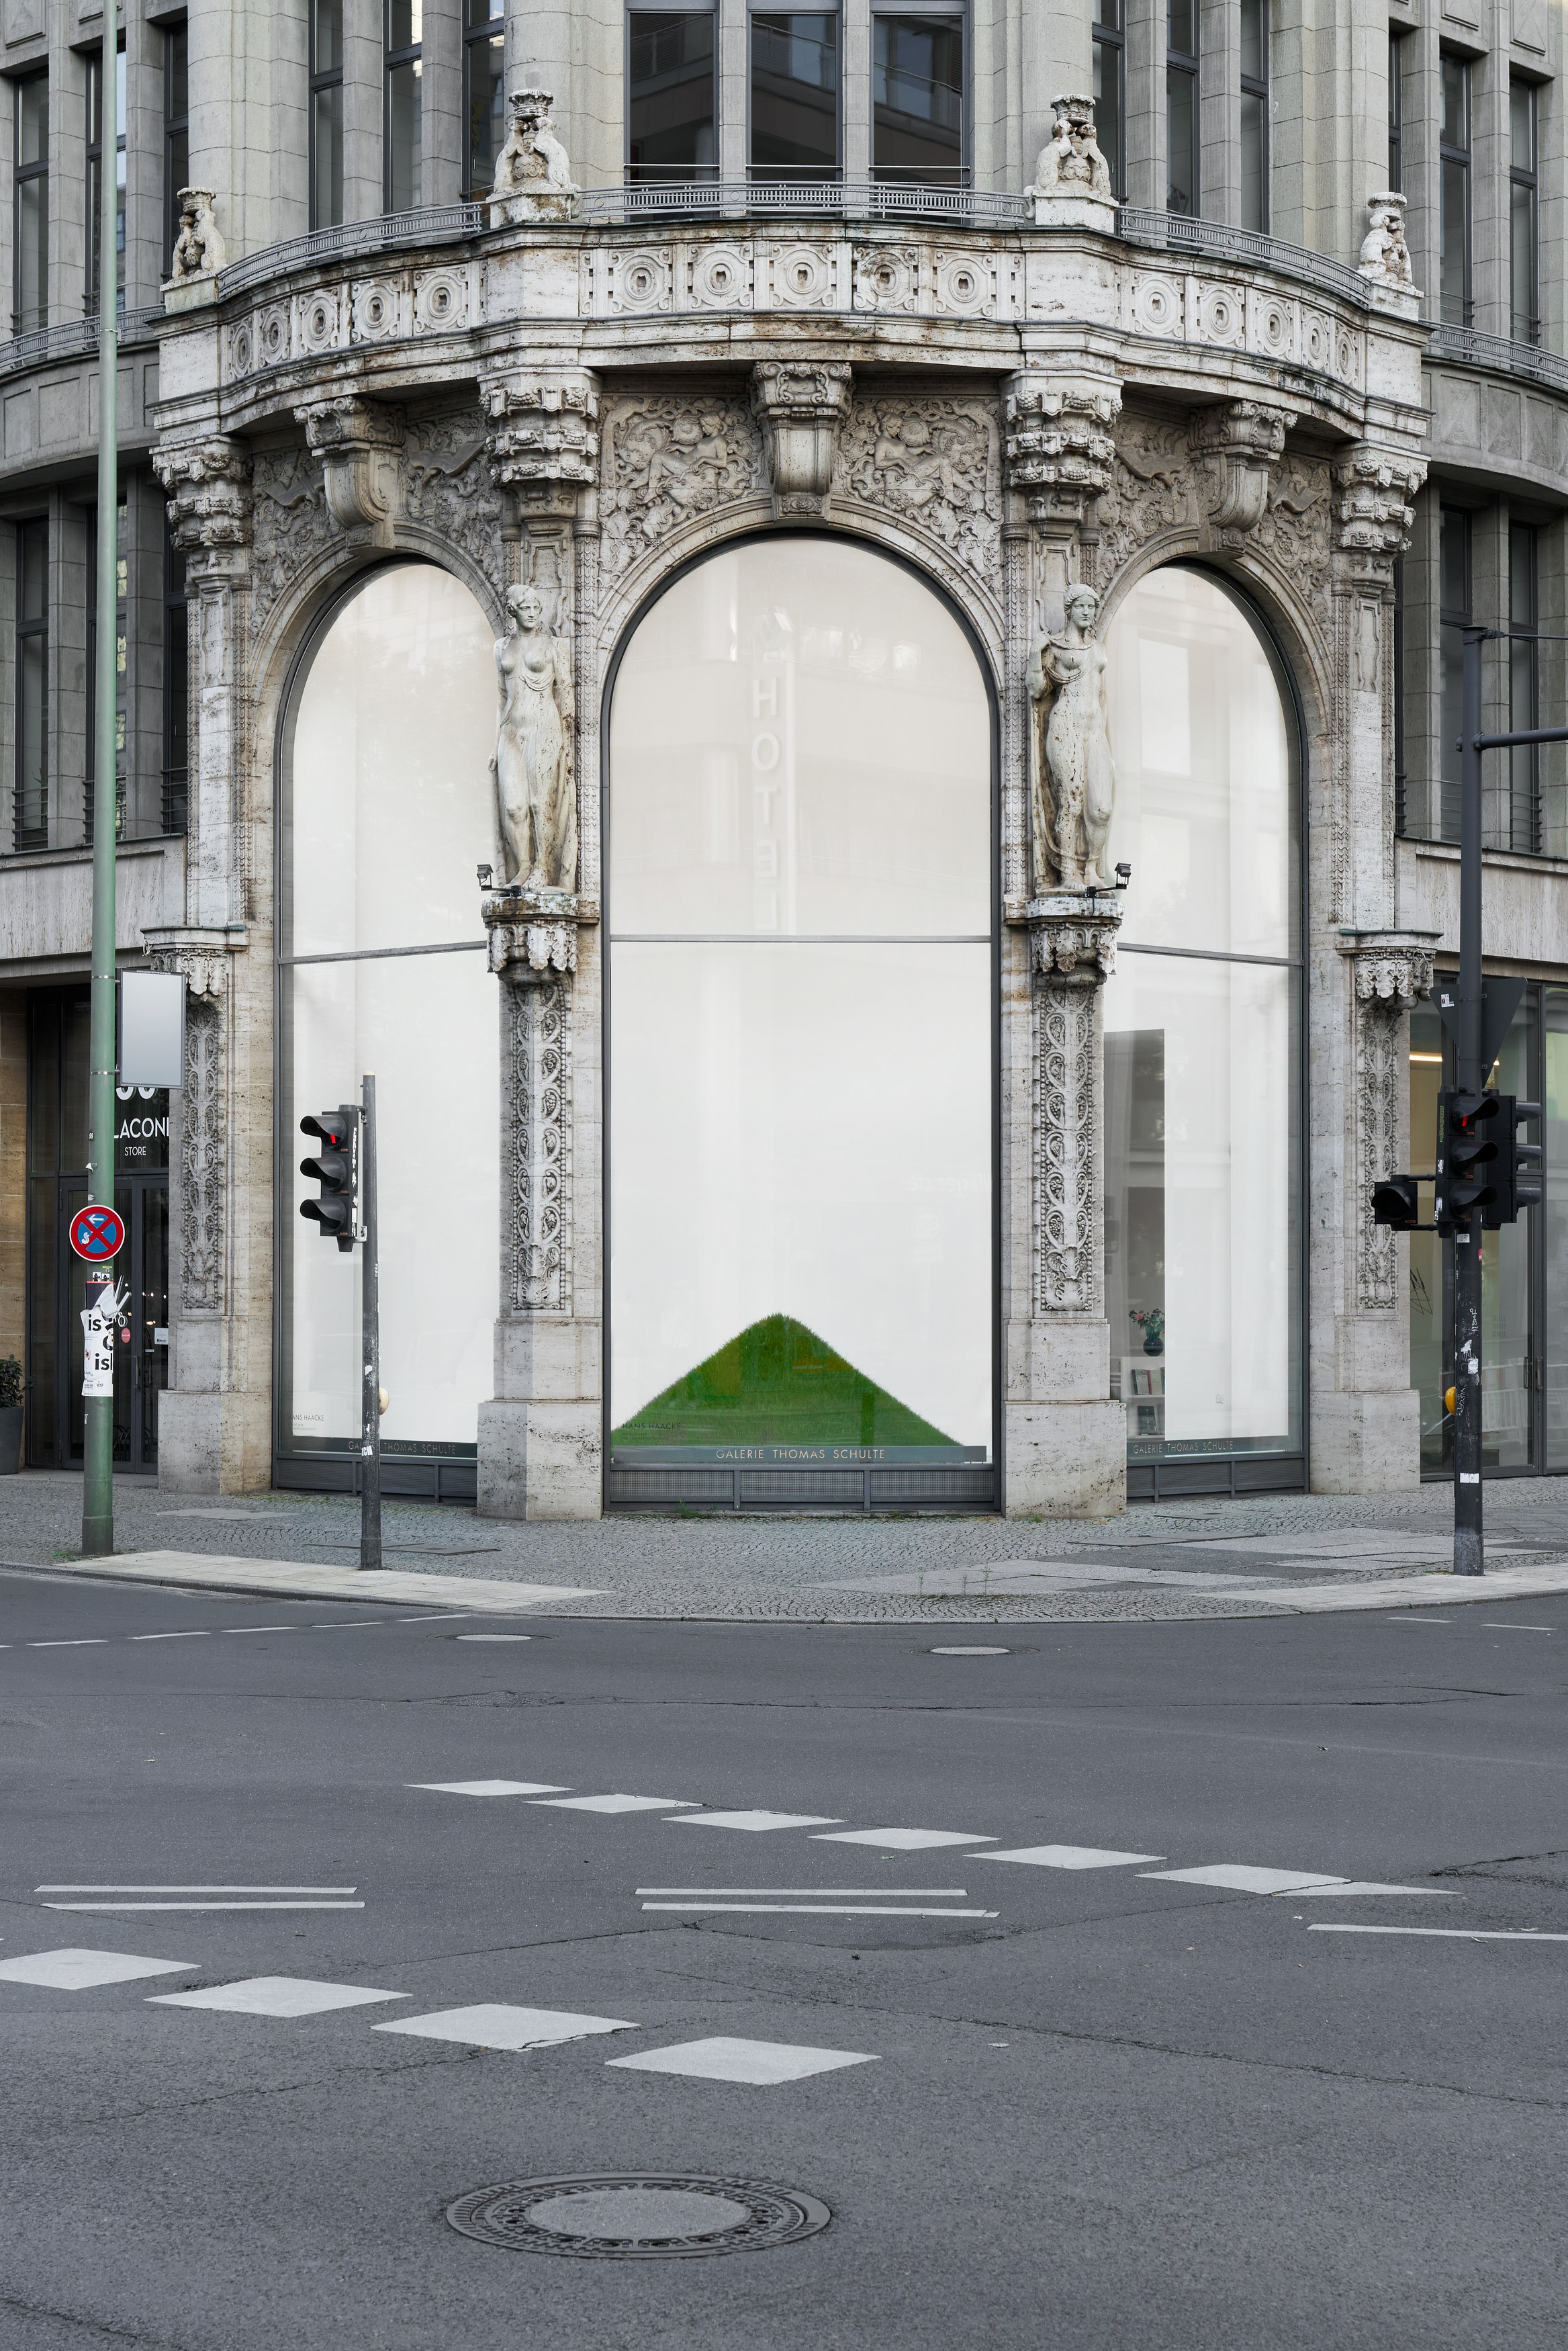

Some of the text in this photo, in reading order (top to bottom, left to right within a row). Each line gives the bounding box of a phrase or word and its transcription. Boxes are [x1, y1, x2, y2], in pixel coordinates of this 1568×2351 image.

[124, 1146, 146, 1156] STORE
[88, 1313, 101, 1331] is
[383, 1443, 456, 1454] THOMAS SCHULTE
[1134, 1441, 1233, 1454] GALERIE THOMAS SCHULTE
[716, 1449, 885, 1459] GALERIE THOMAS SCHULTE
